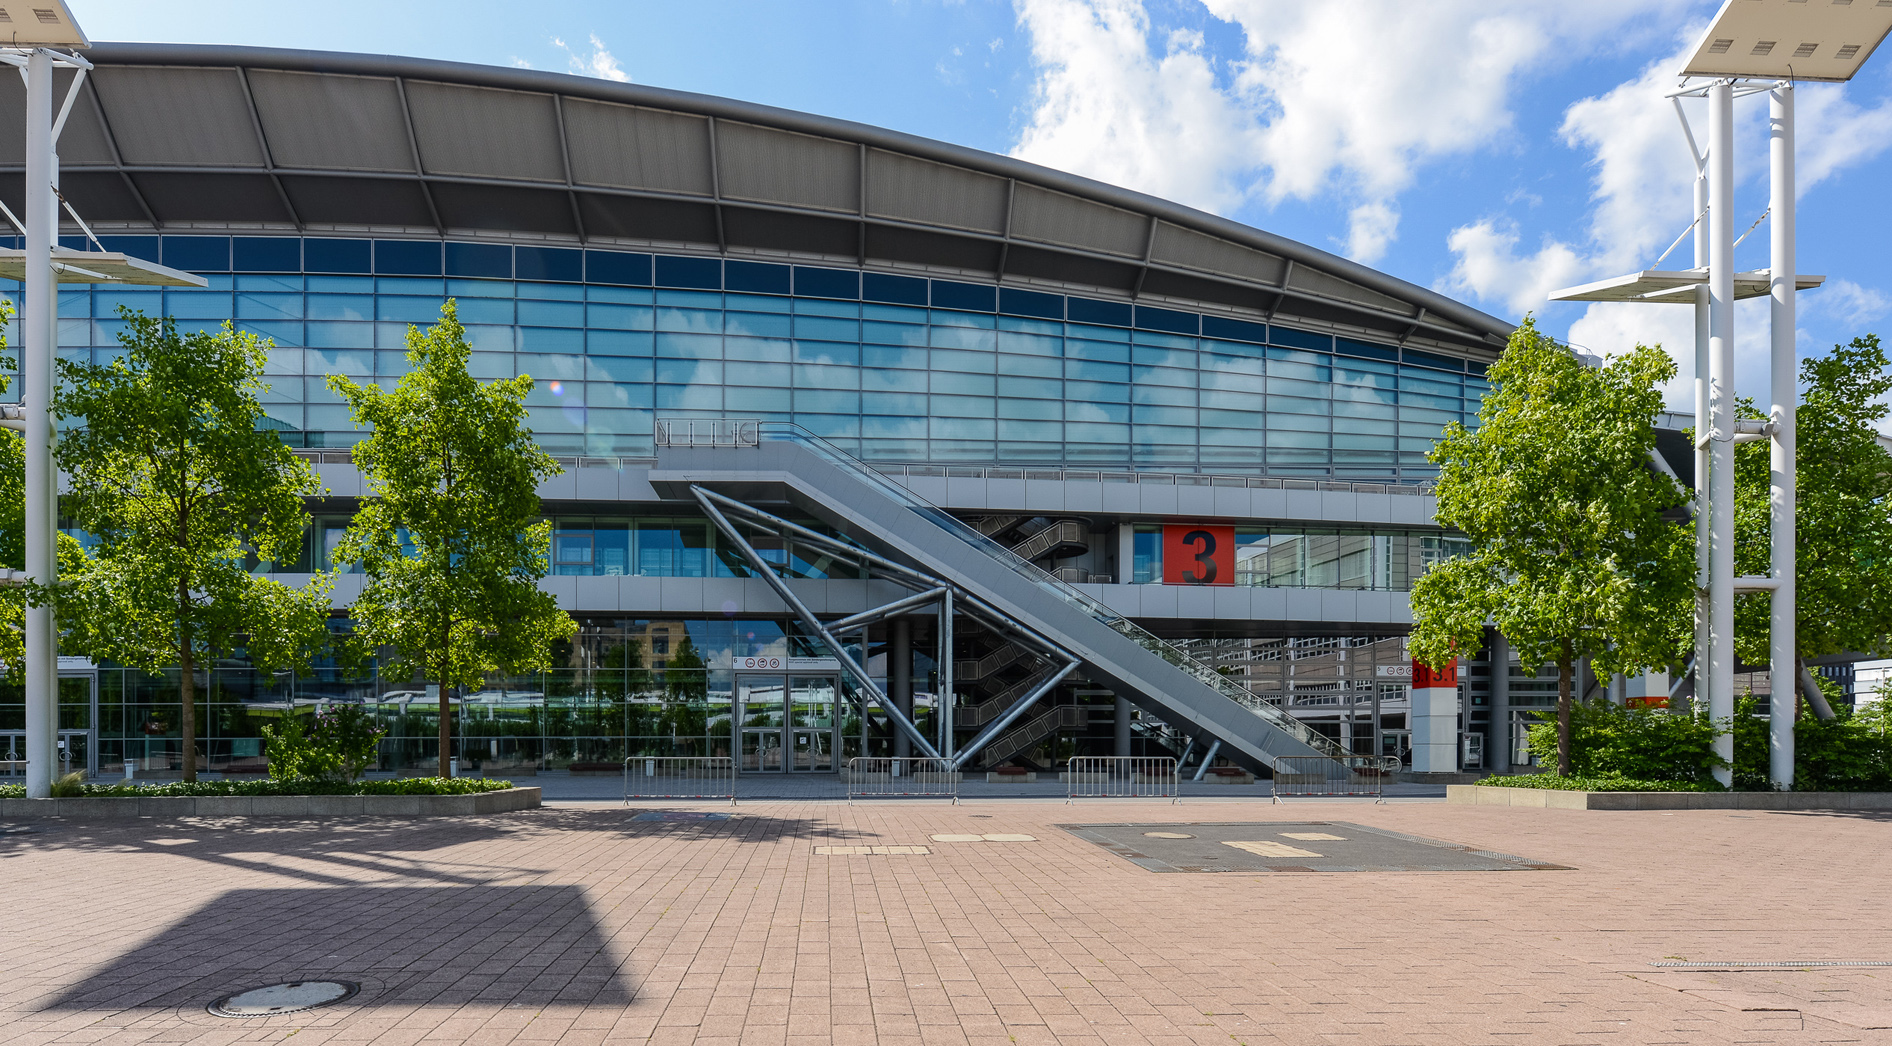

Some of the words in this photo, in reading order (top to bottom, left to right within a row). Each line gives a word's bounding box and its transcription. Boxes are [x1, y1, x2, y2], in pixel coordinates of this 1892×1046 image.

[1182, 530, 1217, 586] 3
[1414, 667, 1428, 683] 3.1
[1433, 667, 1455, 681] 3.1
